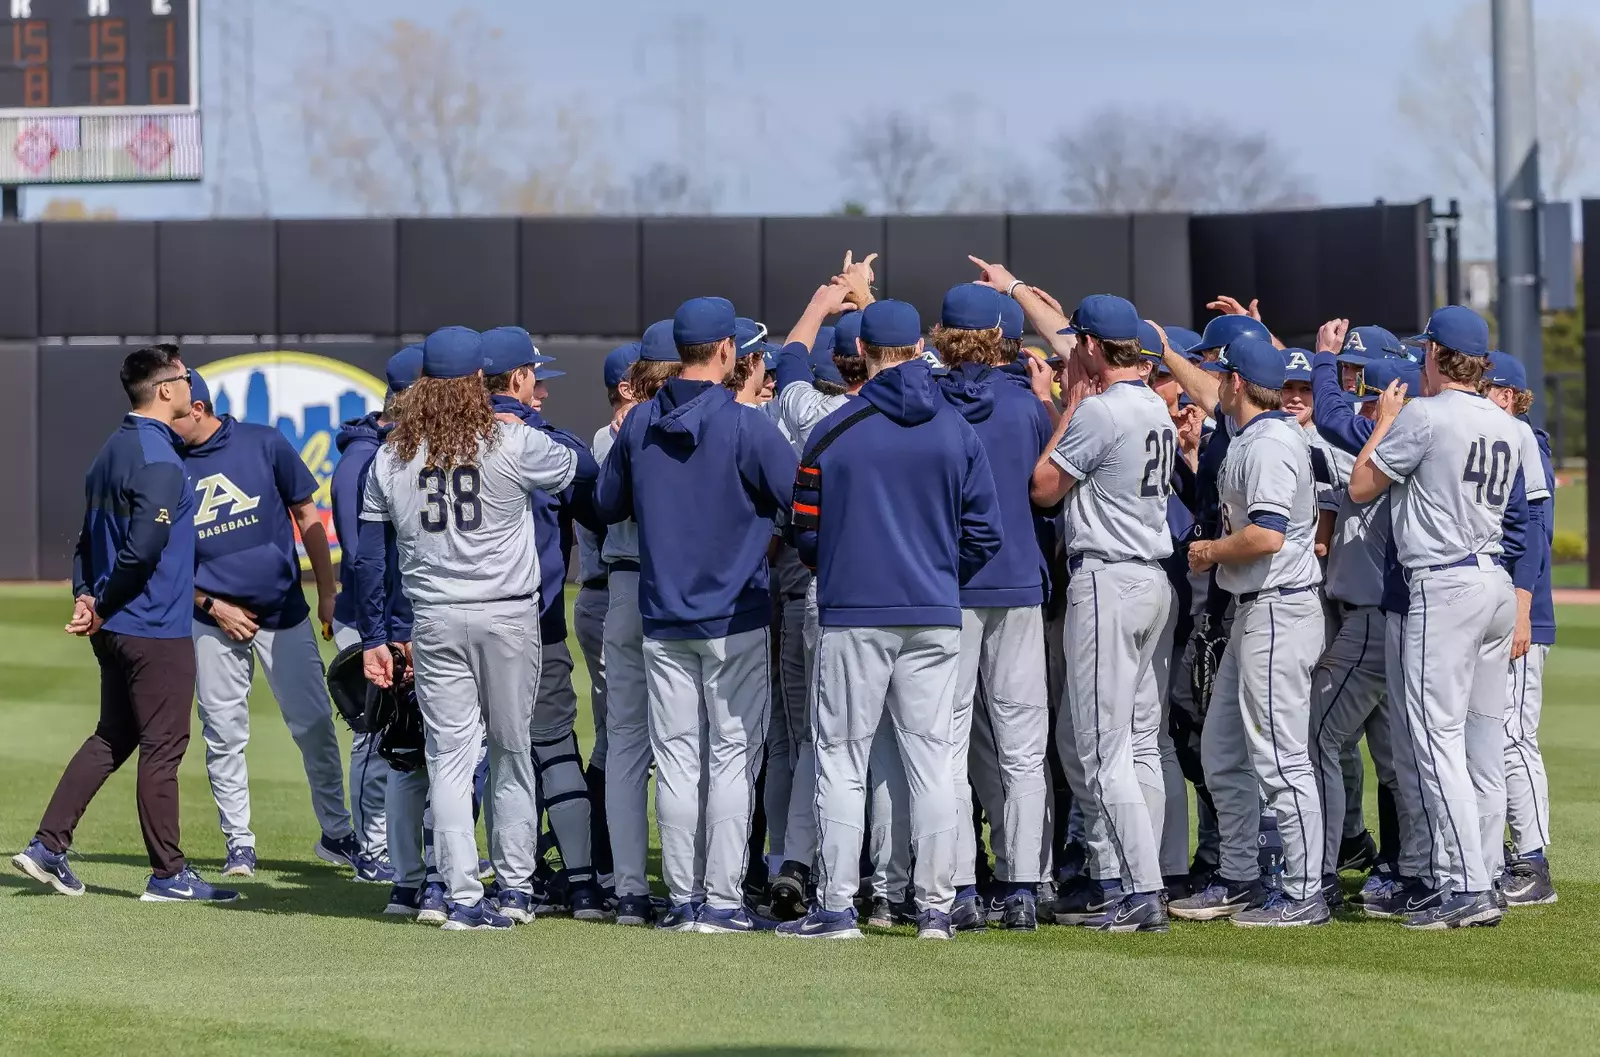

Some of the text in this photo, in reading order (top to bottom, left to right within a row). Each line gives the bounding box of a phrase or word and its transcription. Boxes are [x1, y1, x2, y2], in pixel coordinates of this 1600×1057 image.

[13, 18, 176, 62] 15 15 1
[25, 63, 176, 107] 8 13 0
[1285, 352, 1313, 372] A
[1343, 331, 1367, 352] A
[1140, 428, 1176, 499] 20
[1463, 435, 1511, 508] 40
[154, 508, 172, 525] A
[193, 472, 261, 527] A
[418, 464, 484, 534] 38
[197, 514, 260, 540] BASEBALL
